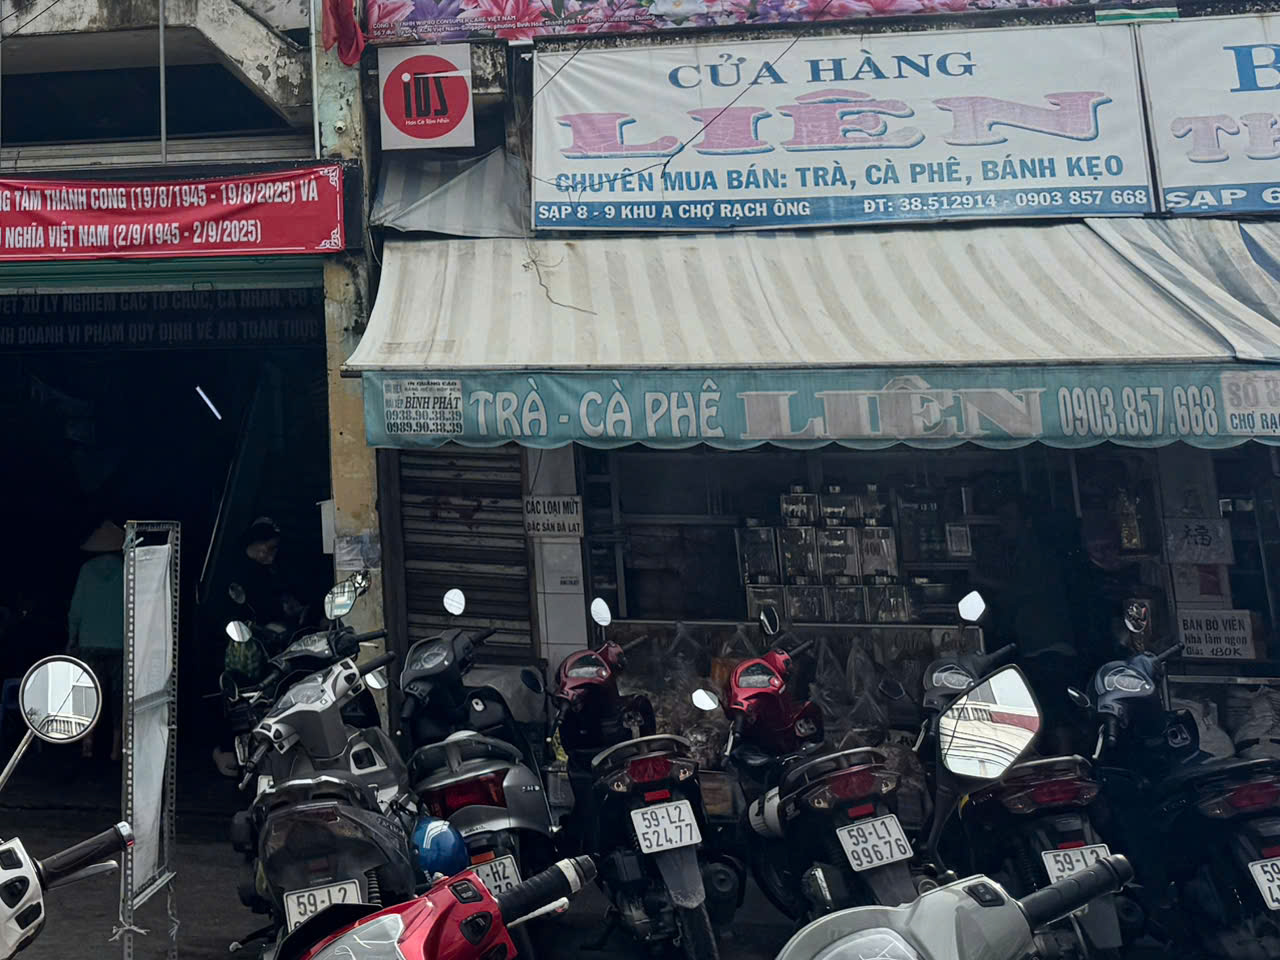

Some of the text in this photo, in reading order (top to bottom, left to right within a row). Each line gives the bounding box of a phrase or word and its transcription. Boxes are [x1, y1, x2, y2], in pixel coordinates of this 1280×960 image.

[669, 49, 977, 90] CỬA HÀNG
[556, 88, 1113, 159] LIÊN
[555, 154, 1124, 192] CHUYÊN MUA BÁN: TRÀ, CÀ PHÊ, BÁNH KẸO
[15, 185, 42, 211] TÁM
[45, 186, 87, 211] THÀNH
[131, 185, 207, 210] (19/8/1945
[220, 180, 296, 205] 19/8/2025)
[300, 175, 319, 202] VÀ
[538, 189, 1148, 221] SẠP 8 9 KHU A CHỢ RẠCH ÔNG ĐT: 38.512914 0903 857 668
[1166, 189, 1248, 209] SẠP
[5, 222, 45, 249] NGHĨA
[48, 221, 75, 252] VIỆT
[78, 224, 109, 247] NAM
[113, 222, 180, 249] (2/9/1945
[193, 219, 261, 244] 2/9/2025)
[404, 392, 431, 409] BÌNH
[432, 392, 462, 410] PHÁT
[469, 378, 726, 438] TRÀ CÀ PHÊ
[737, 375, 1047, 439] LIÊN
[1057, 385, 1220, 436] 0903.857.668
[1230, 411, 1256, 433] CHỢ
[525, 497, 541, 514] CÁC
[543, 500, 560, 517] LOẠI
[1205, 632, 1247, 646] làm ngon
[642, 804, 686, 830] 59-L2
[642, 823, 694, 850] 524.77
[847, 820, 892, 847] 59-L1
[851, 839, 908, 869] 996.76
